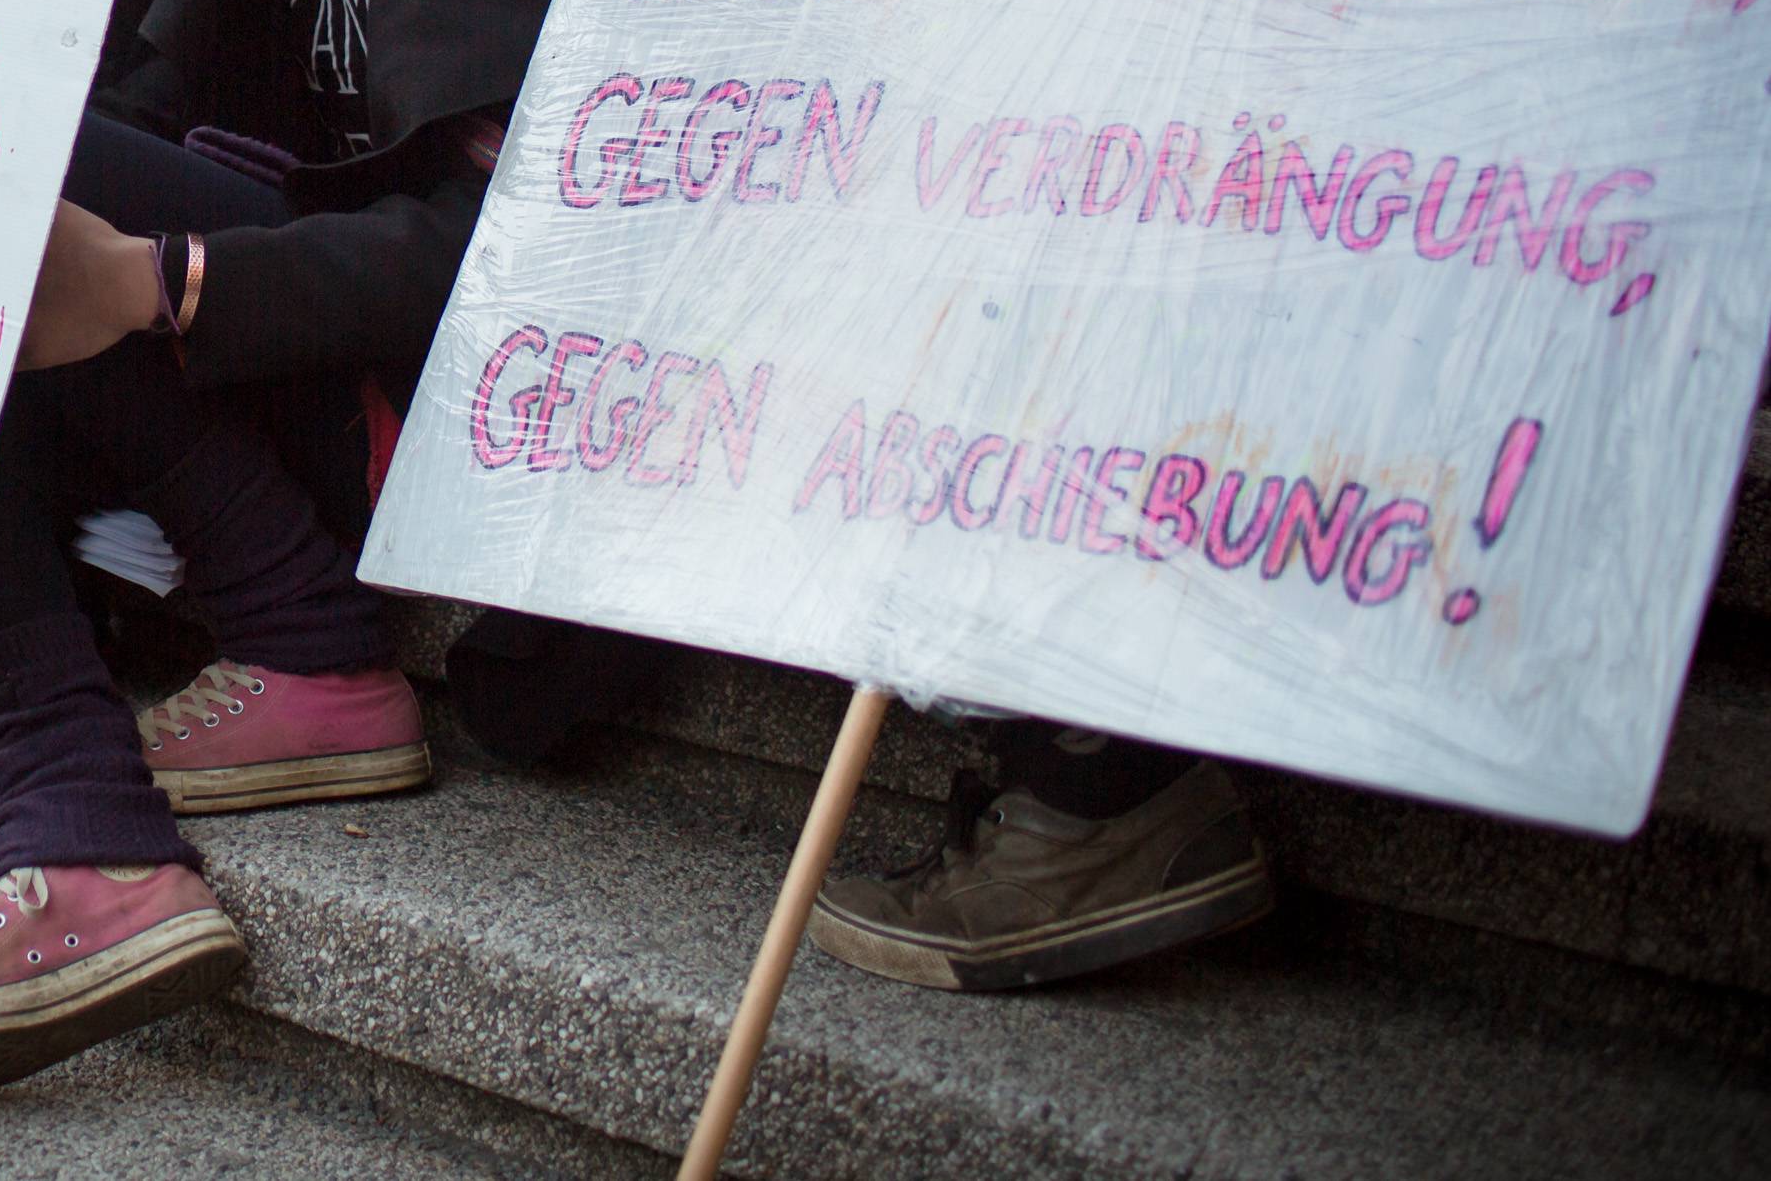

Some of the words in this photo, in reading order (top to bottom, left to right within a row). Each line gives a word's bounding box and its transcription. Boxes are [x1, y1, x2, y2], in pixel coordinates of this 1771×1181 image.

[558, 72, 884, 209] GEGEN
[915, 111, 1658, 317] VERDRÄNGUNG,
[470, 324, 775, 490] GEGEN
